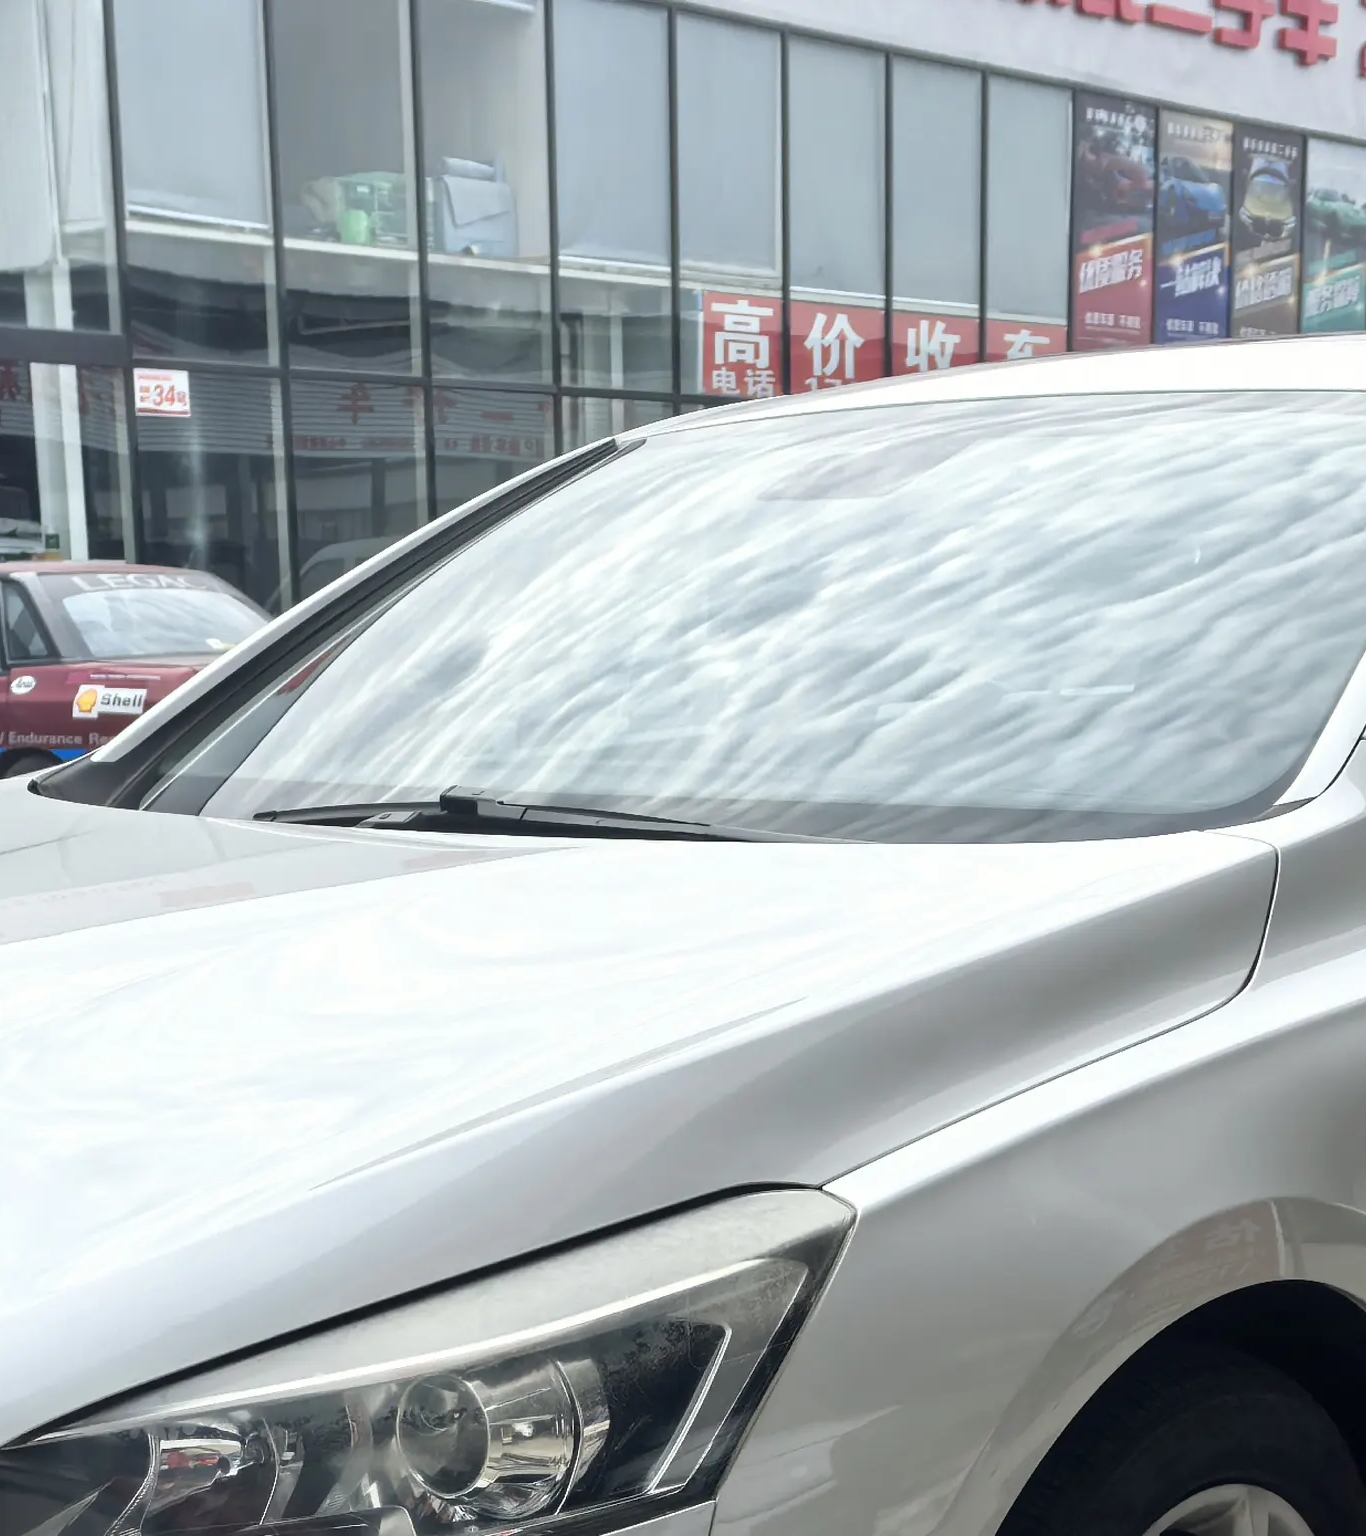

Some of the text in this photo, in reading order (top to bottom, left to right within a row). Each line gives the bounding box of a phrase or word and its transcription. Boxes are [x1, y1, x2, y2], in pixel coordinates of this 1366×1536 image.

[712, 368, 776, 398] 电话
[100, 693, 143, 708] Shell
[8, 731, 83, 745] Endurance
